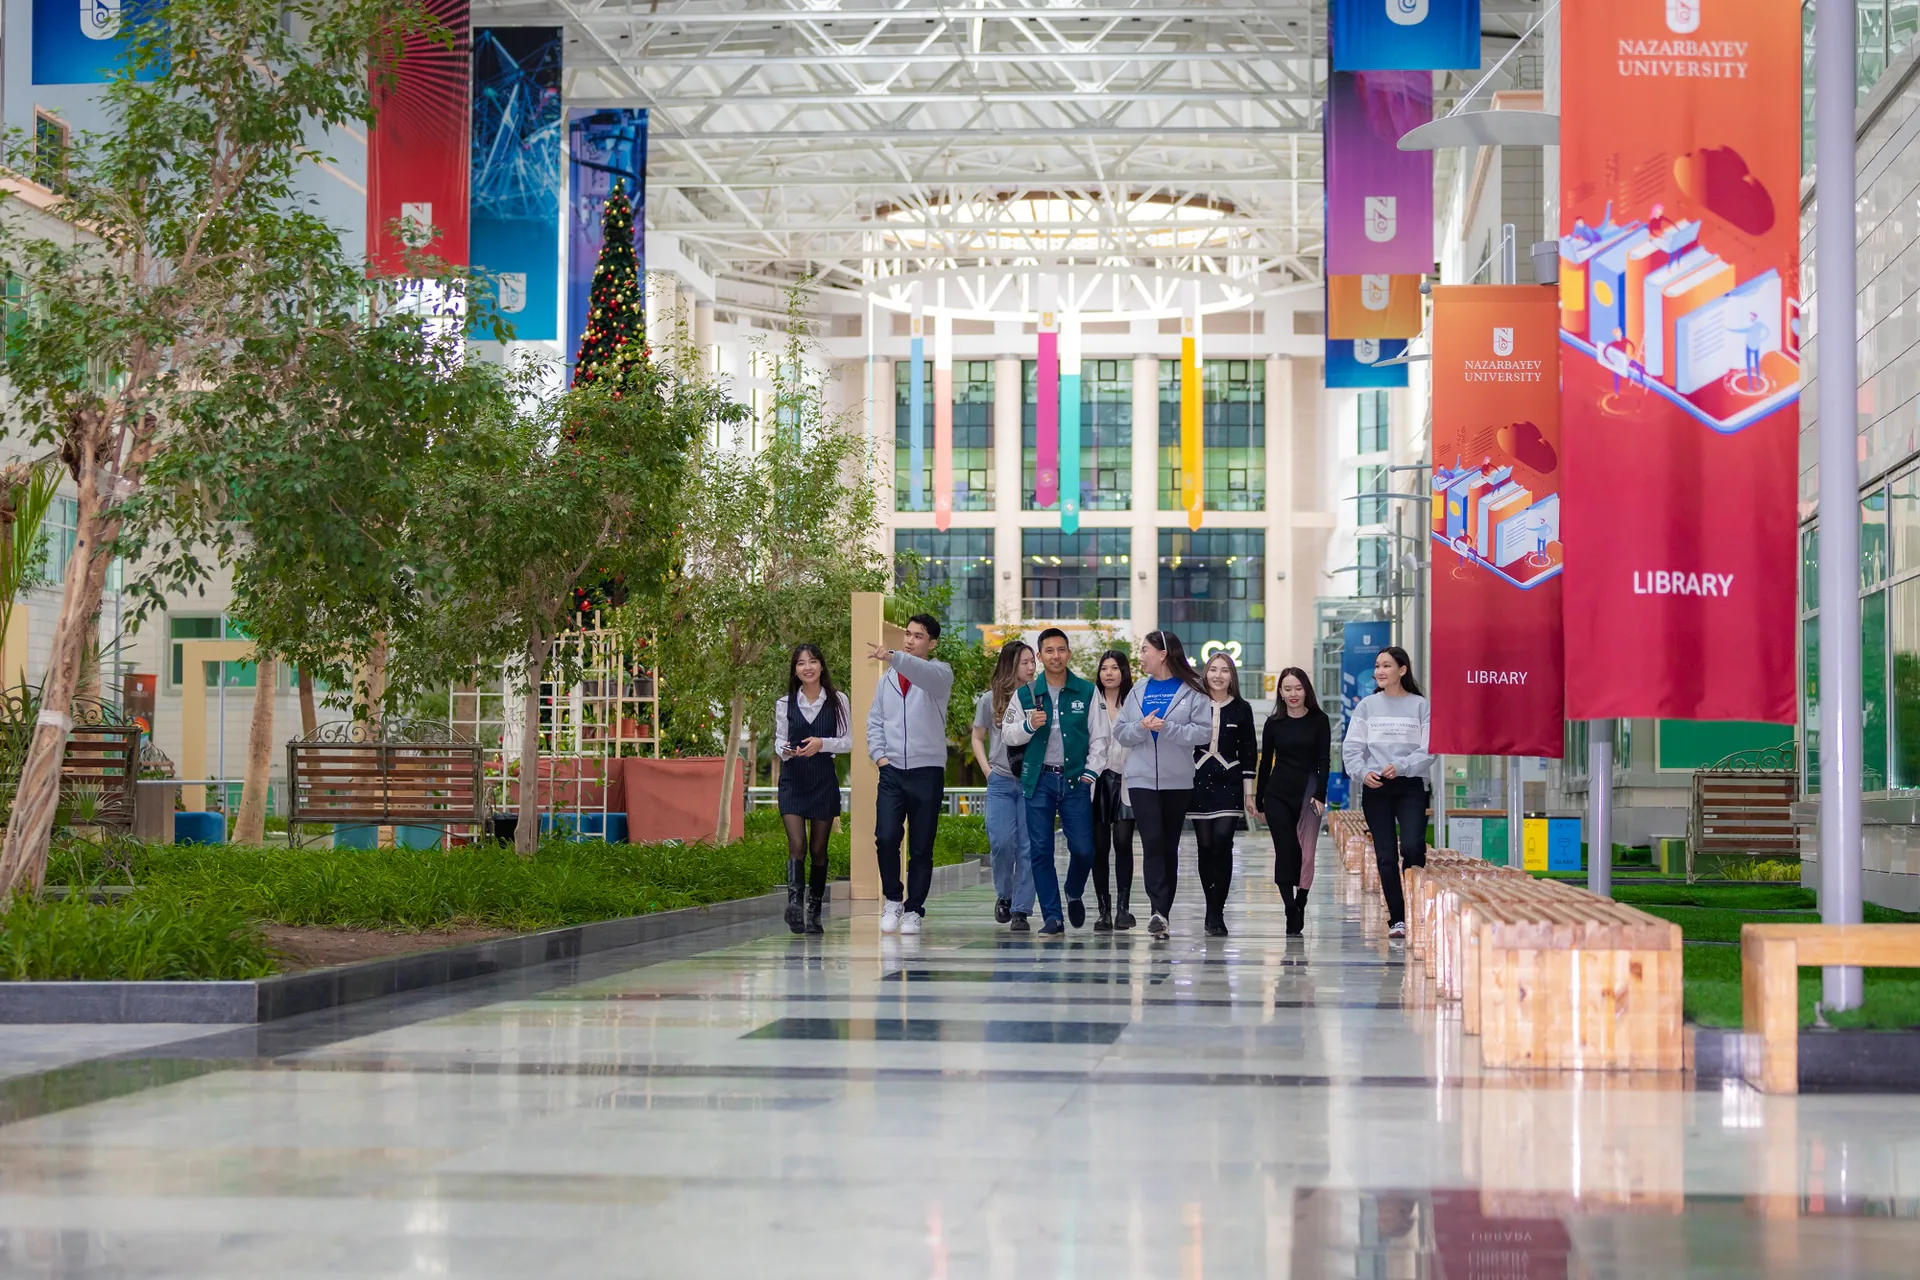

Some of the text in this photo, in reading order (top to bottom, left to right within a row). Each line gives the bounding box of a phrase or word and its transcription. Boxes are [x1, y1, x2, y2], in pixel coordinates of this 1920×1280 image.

[1618, 39, 1748, 58] NAZARBAYEV
[1618, 60, 1748, 78] UNIVERSITY
[1464, 360, 1542, 370] NAZARBAYEV
[1464, 372, 1542, 382] UNIVERSITY
[1633, 570, 1733, 597] LIBRARY
[1201, 640, 1243, 668] C2
[1466, 671, 1528, 685] LIBRARY
